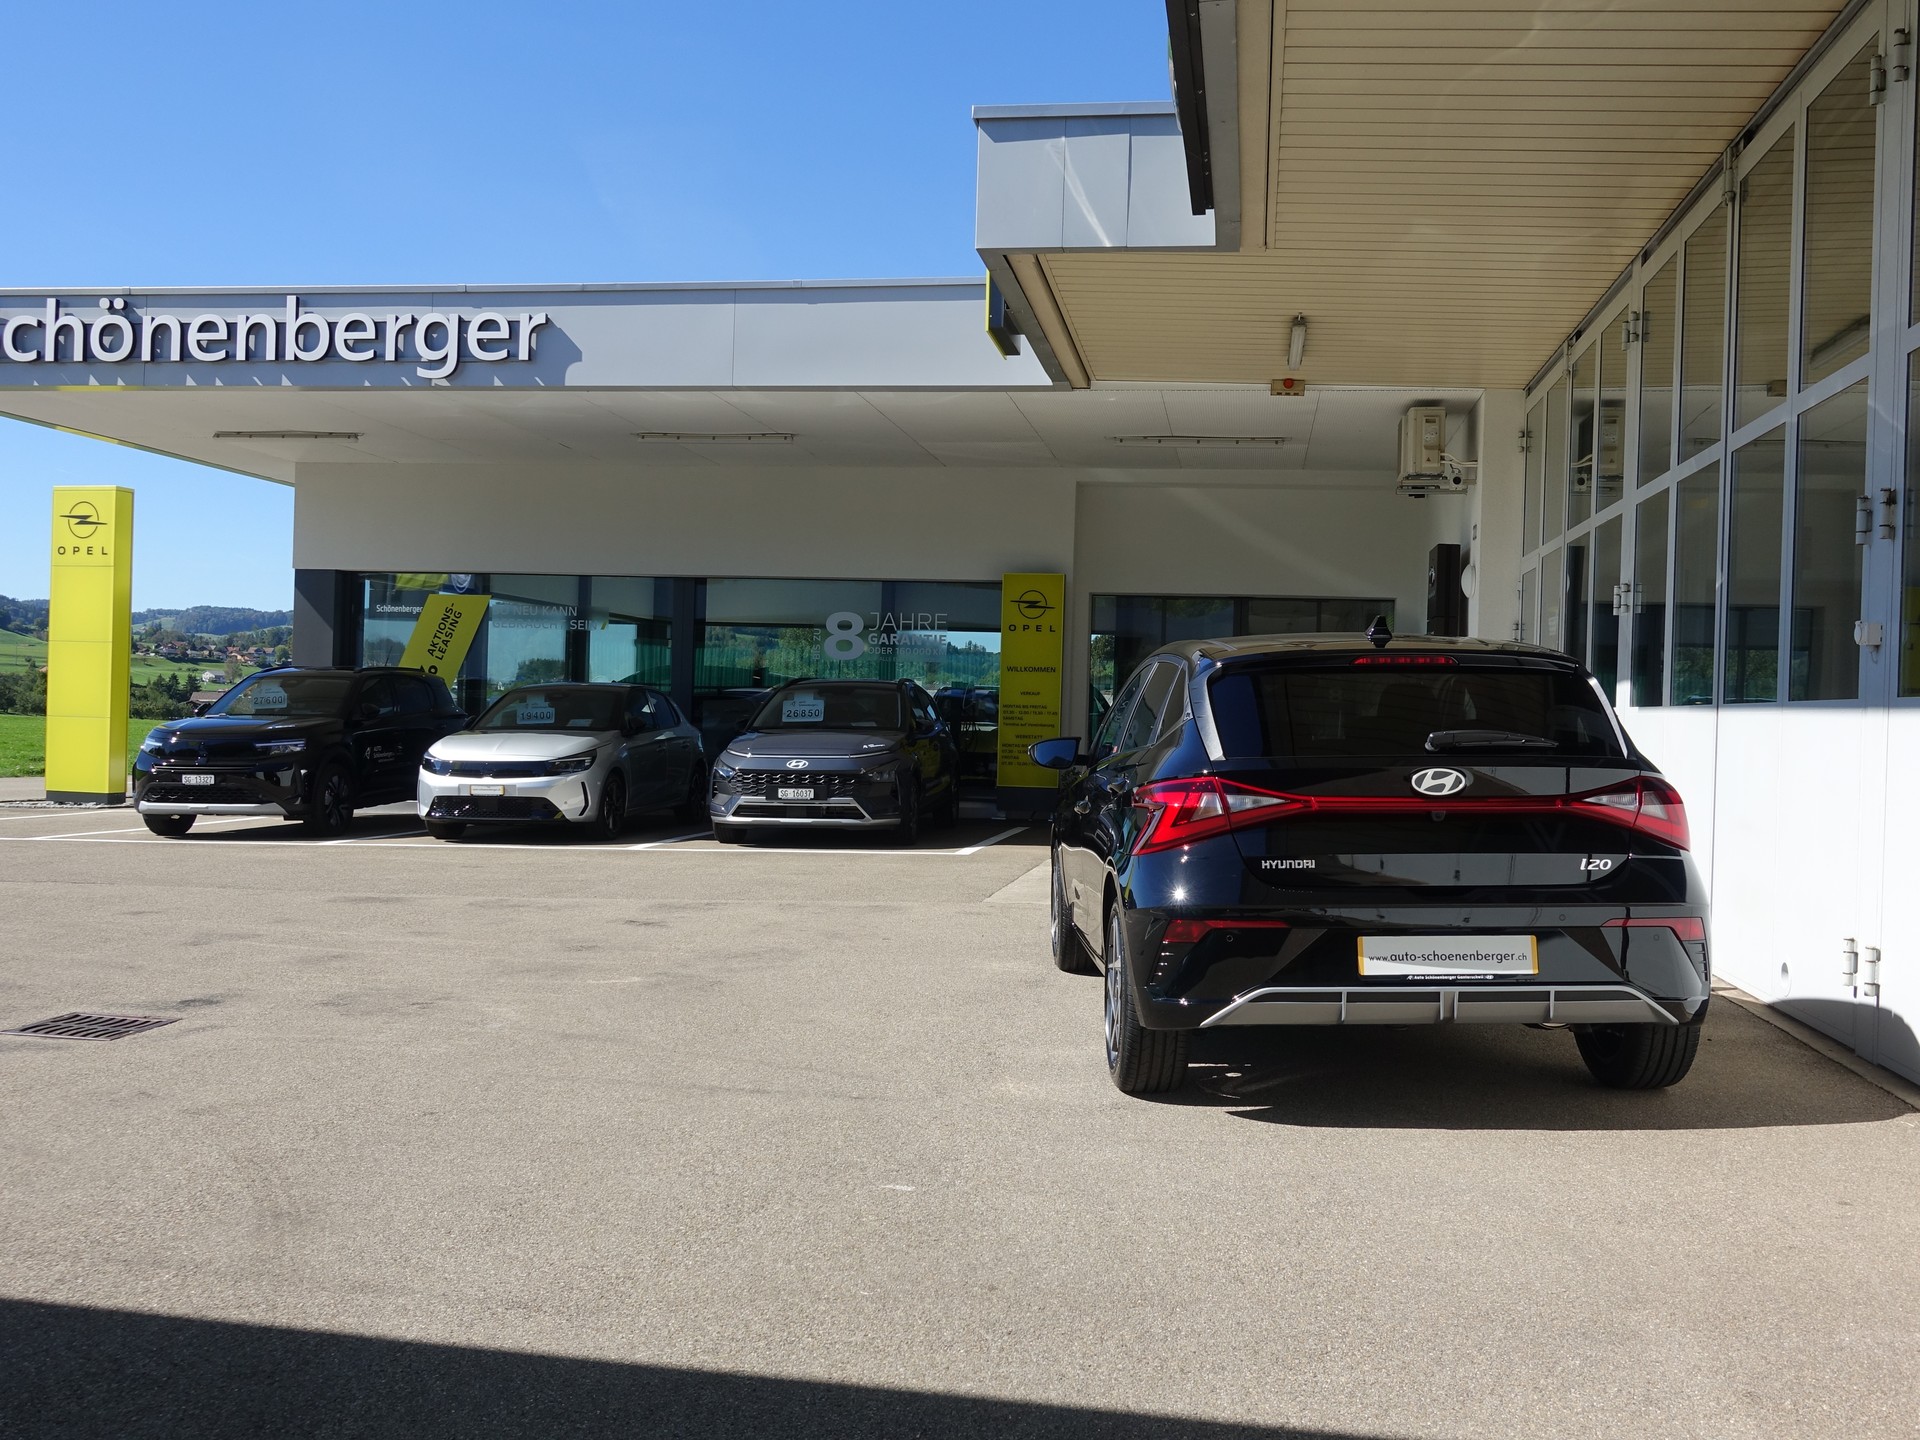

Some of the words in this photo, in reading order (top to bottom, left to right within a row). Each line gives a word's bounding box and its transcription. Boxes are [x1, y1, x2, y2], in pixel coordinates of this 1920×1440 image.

[2, 295, 549, 379] chönenberger
[57, 546, 108, 556] OPEL
[376, 604, 423, 615] Schönenberger
[513, 606, 538, 616] NEU
[542, 606, 578, 617] KANN
[868, 612, 948, 631] JAHRE
[427, 602, 455, 657] AKTIONS-
[1008, 624, 1056, 633] OPEL
[435, 610, 462, 661] LEASING
[823, 611, 865, 661] 8
[867, 633, 947, 646] GARANTIE
[868, 647, 893, 655] ODER
[786, 709, 820, 718] 26850
[1261, 860, 1316, 869] HYUNDAI
[1368, 950, 1528, 964] www.auto-schoenenberger.ch
